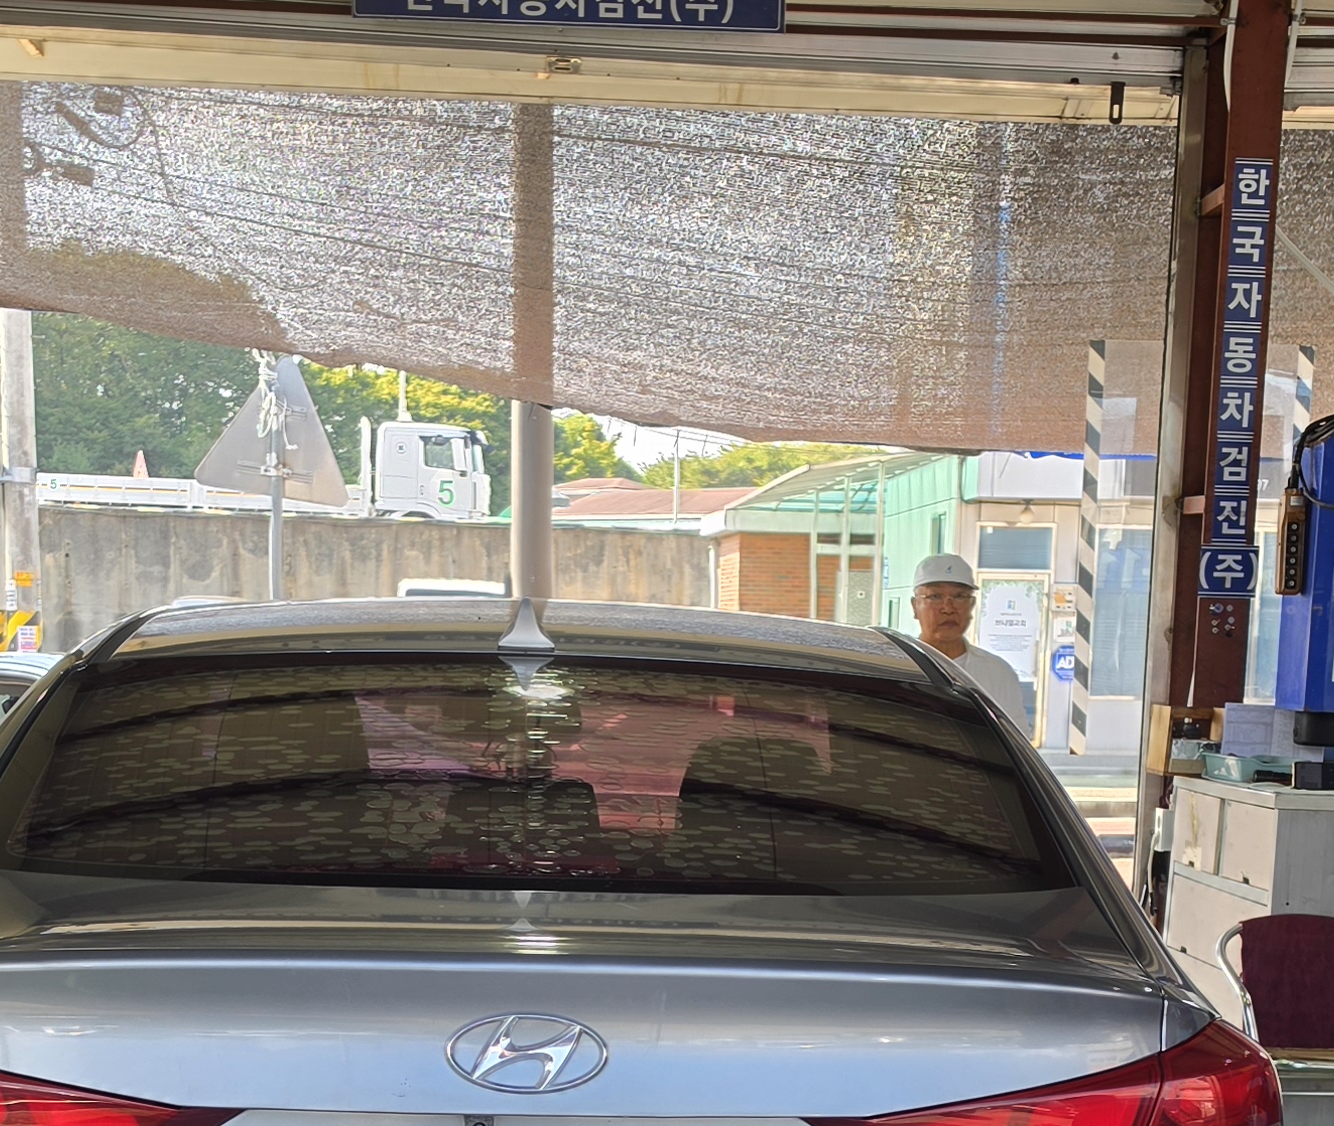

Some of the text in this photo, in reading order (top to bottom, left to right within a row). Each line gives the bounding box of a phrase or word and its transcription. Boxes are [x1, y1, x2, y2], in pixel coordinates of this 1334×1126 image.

[1198, 167, 1271, 590] 한국자동차검진(주)
[50, 478, 57, 490] 5
[438, 480, 455, 506] 5
[1055, 656, 1075, 670] AD
